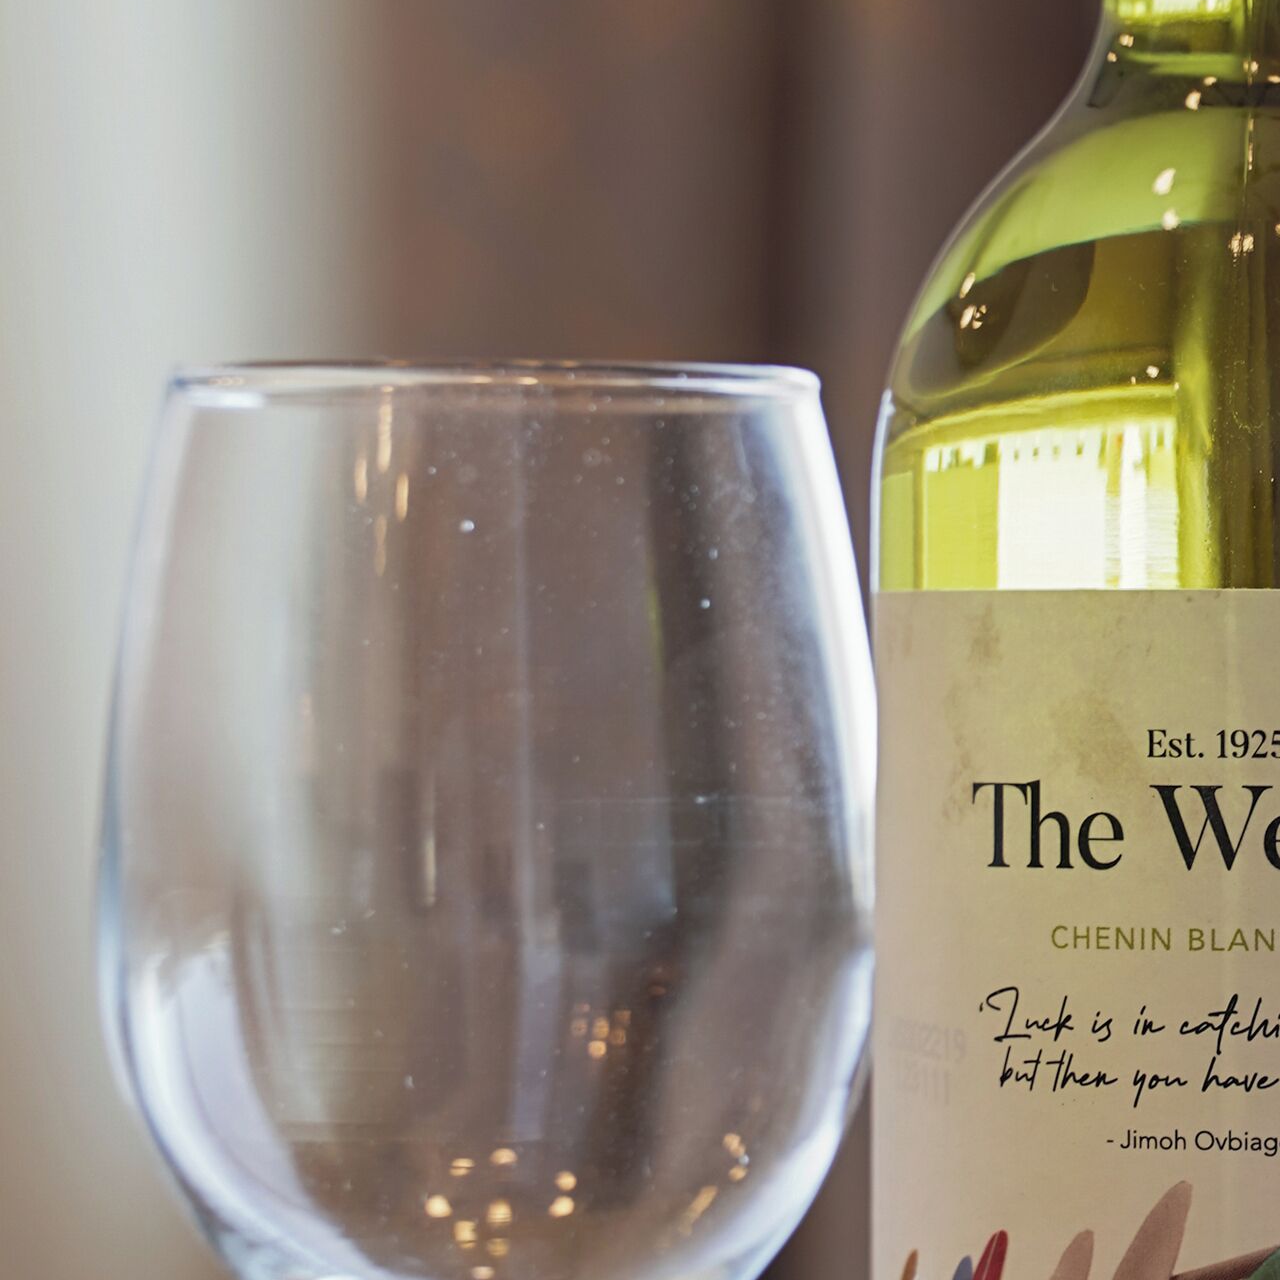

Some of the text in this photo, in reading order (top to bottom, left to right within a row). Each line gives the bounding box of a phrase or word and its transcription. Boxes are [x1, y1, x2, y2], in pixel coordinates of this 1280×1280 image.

[1147, 729, 1205, 759] Est.
[972, 779, 1125, 871] The
[1050, 925, 1172, 951] CHENIN
[1091, 1011, 1113, 1042] is
[1132, 1005, 1165, 1035] in
[1000, 1045, 1042, 1091] but
[1045, 1049, 1118, 1092] then
[1132, 1069, 1188, 1108] you
[1201, 1056, 1280, 1092] have
[1119, 1128, 1187, 1151] Jimoh
